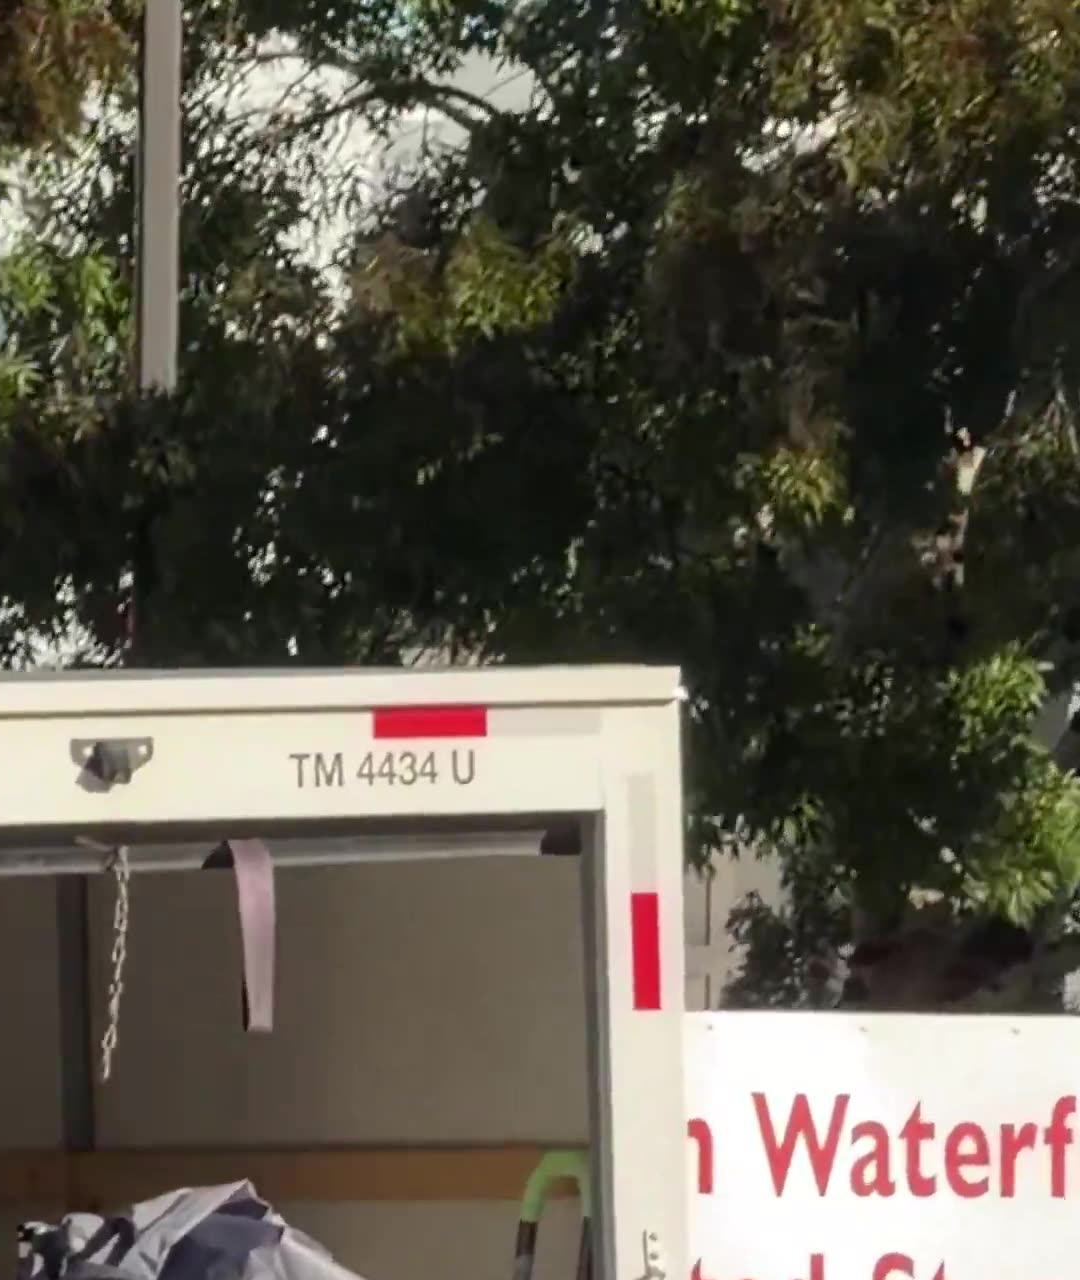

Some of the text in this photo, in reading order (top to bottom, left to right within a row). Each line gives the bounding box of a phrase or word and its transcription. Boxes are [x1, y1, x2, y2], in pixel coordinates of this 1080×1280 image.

[289, 749, 476, 788] TM 4434 U
[751, 1092, 1077, 1200] Waterf
